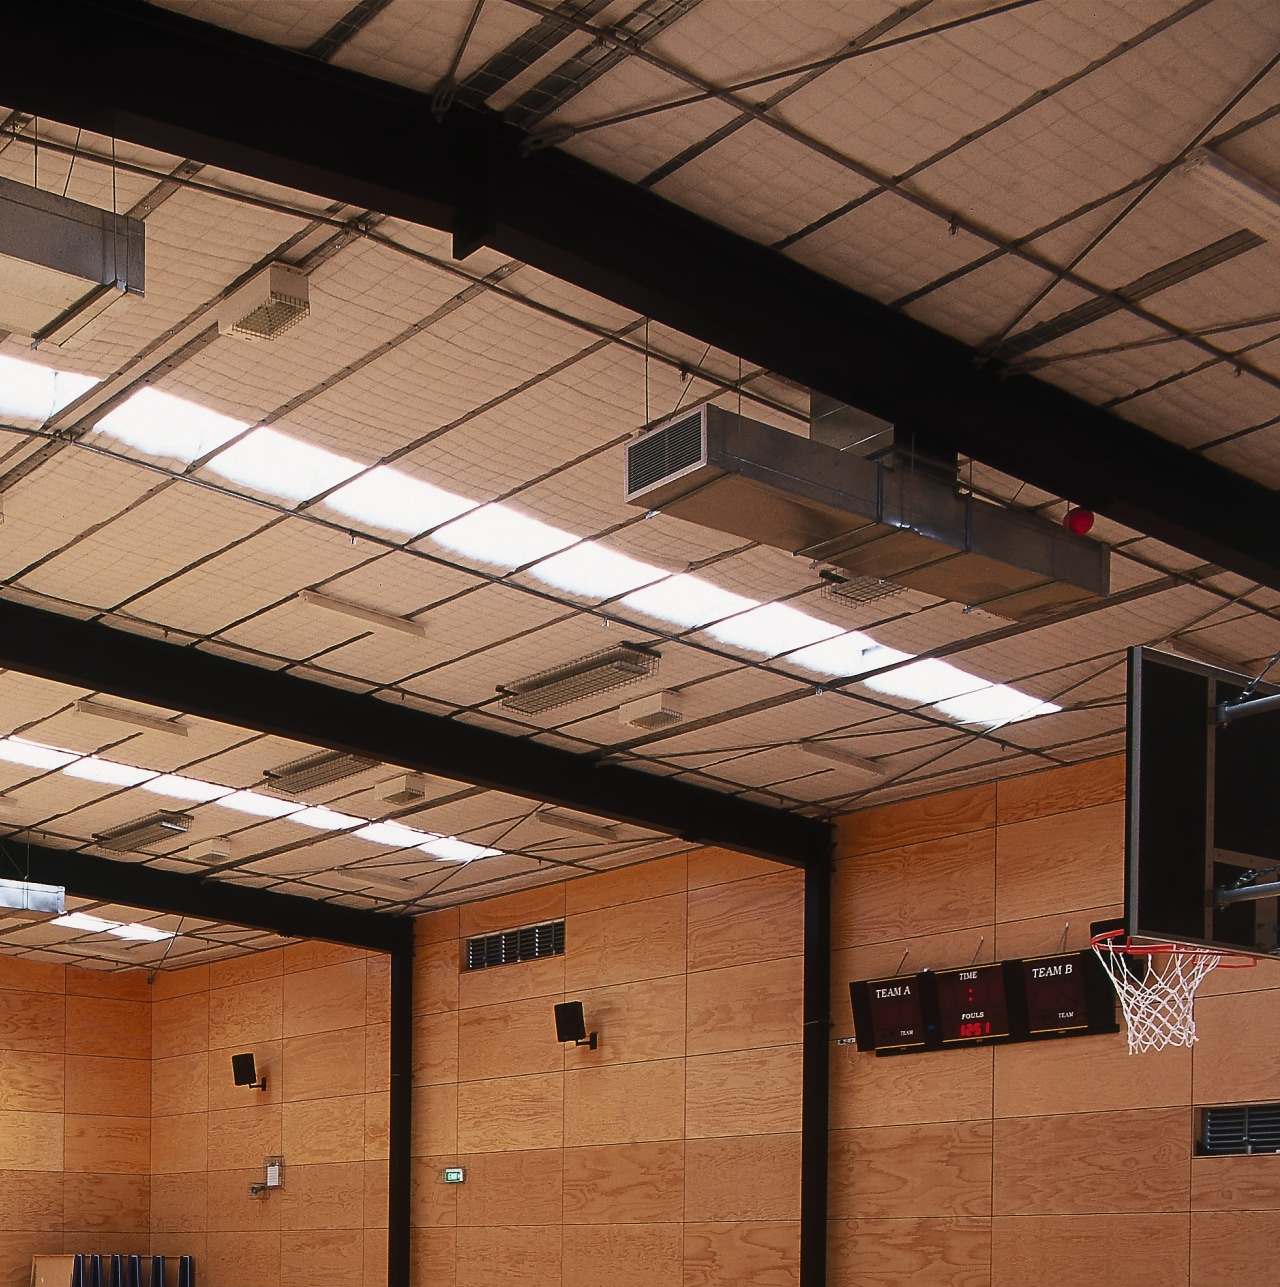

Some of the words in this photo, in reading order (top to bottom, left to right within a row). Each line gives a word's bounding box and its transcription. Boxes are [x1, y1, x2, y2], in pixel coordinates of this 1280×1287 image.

[959, 971, 978, 981] TIME
[1032, 965, 1062, 979] TEAM
[1064, 963, 1073, 975] B
[875, 986, 902, 999] TEAM
[903, 985, 911, 996] A
[961, 1011, 985, 1020] FOULS
[1058, 1011, 1074, 1019] TEAM
